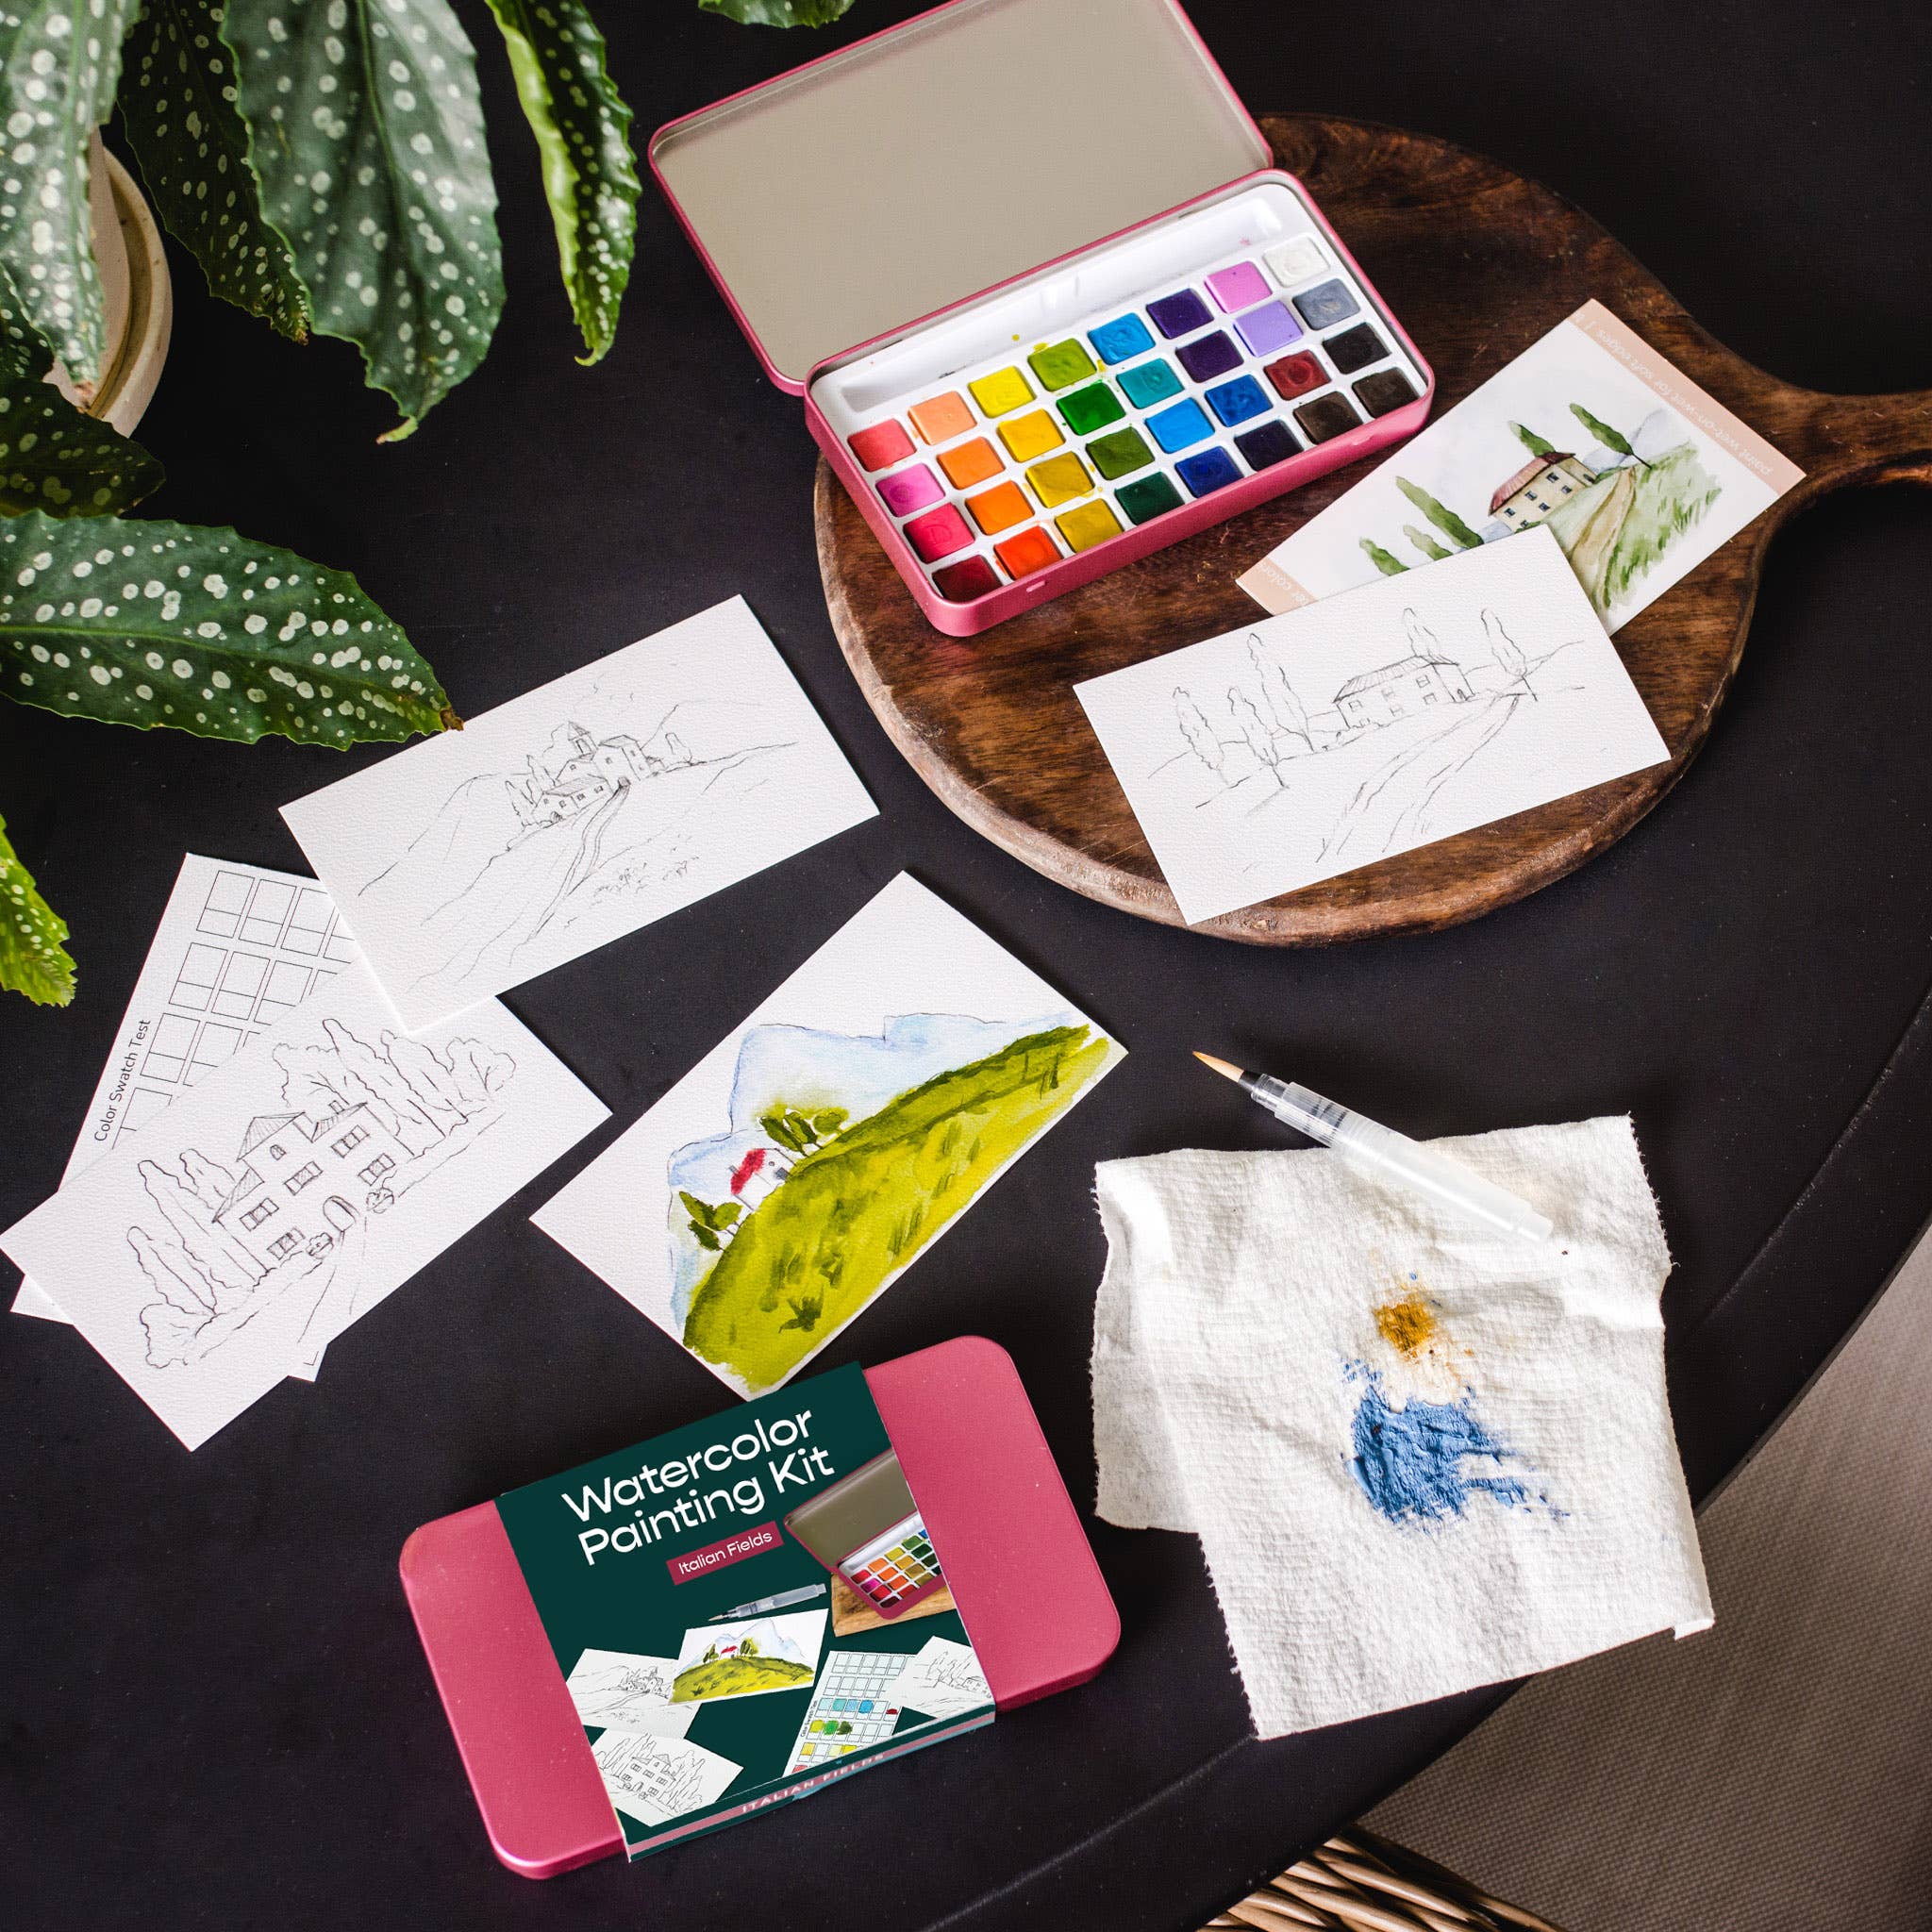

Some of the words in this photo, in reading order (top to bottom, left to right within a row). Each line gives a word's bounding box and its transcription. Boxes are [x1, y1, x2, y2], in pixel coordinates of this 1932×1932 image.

[94, 1106, 117, 1141] Color
[109, 1053, 138, 1102] Swatch
[128, 1020, 150, 1047] Test
[561, 1410, 812, 1523] Watercolor
[578, 1476, 765, 1566] Painting
[768, 1446, 835, 1493] Kit
[678, 1550, 725, 1574] Italian
[727, 1532, 772, 1557] Fields
[742, 1780, 814, 1813] ITALIAN
[823, 1754, 884, 1781] FIELDS
